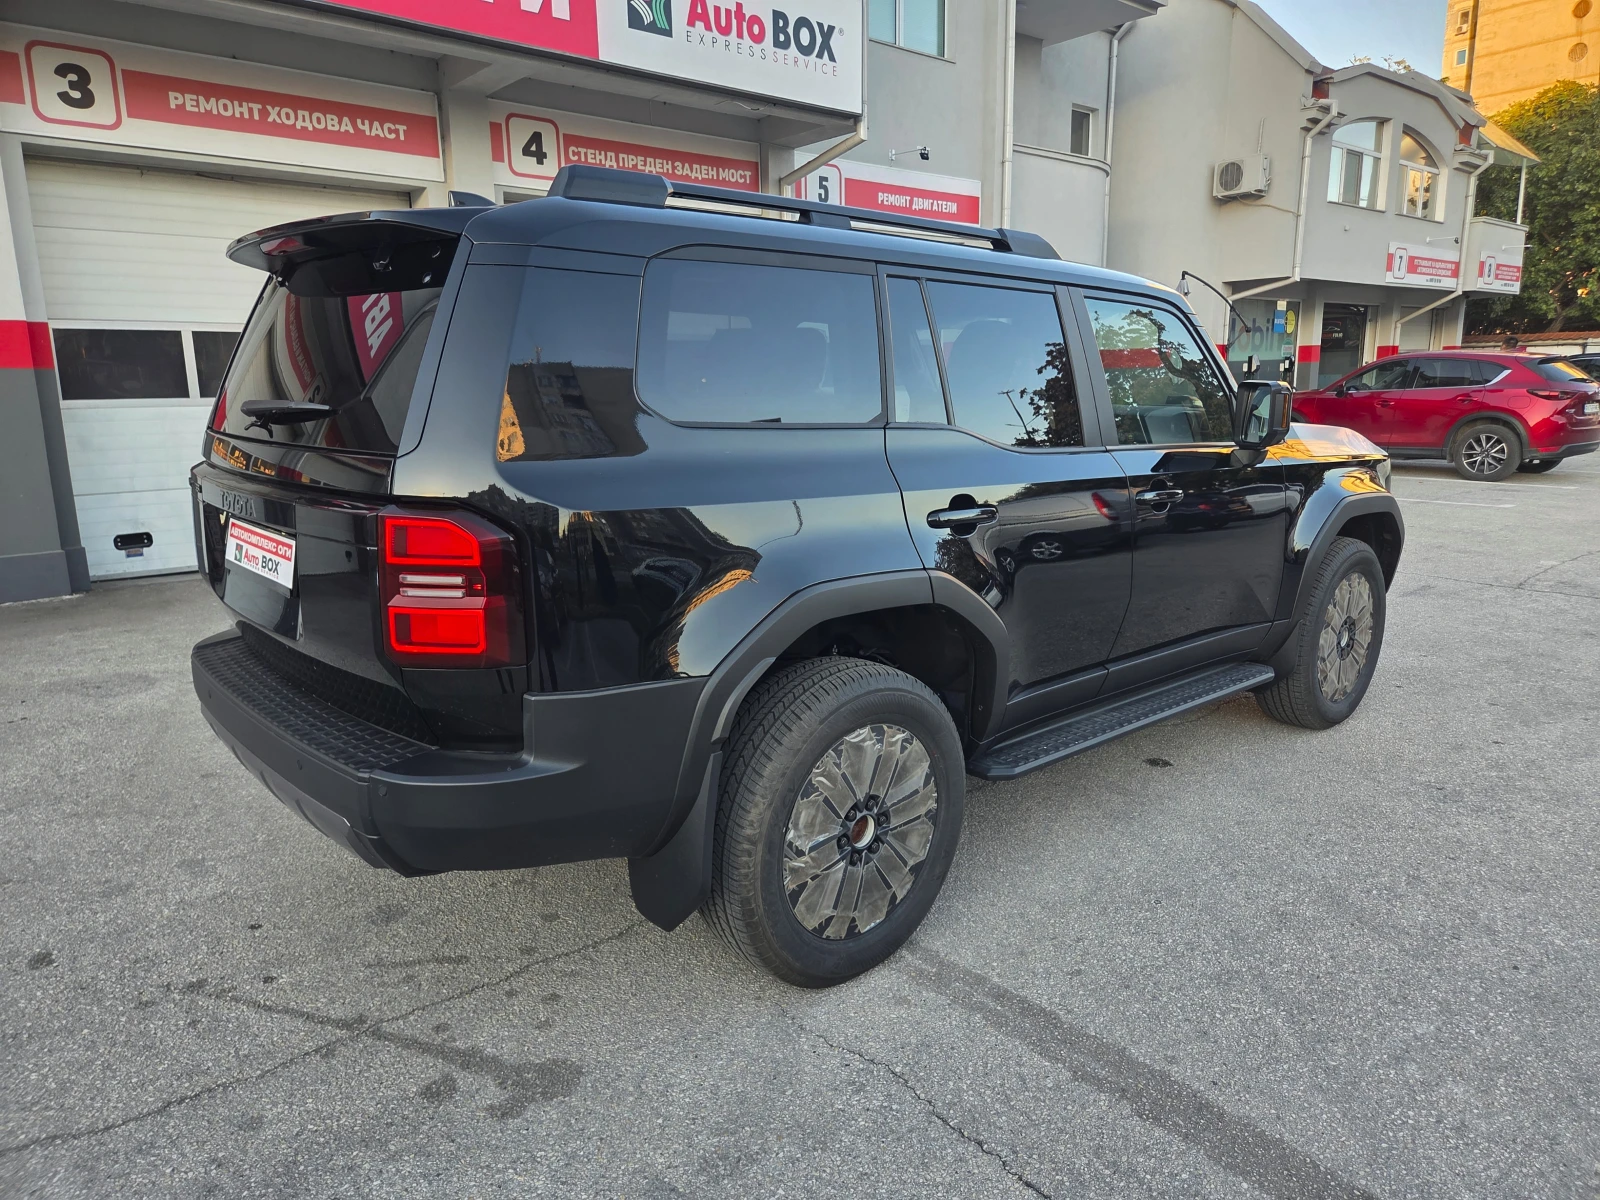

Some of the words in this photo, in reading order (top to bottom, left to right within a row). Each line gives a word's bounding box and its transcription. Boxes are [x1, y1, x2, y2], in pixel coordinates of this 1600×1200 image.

[686, 0, 766, 44] Auto
[772, 9, 837, 63] BOX
[54, 63, 95, 109] 3
[169, 91, 262, 122] РЕМОНТ
[267, 105, 354, 134] ХОДОВА
[357, 118, 407, 141] ЧАСТ
[522, 131, 547, 165] 4
[568, 146, 616, 168] СТЕНД
[618, 153, 672, 174] ПРЕДЕН
[674, 161, 717, 180] ЗАДЕН
[719, 168, 752, 184] МОСТ
[818, 175, 830, 204] 5
[878, 192, 911, 208] РЕМОНТ
[912, 197, 958, 214] ДВИГАТЕЛИ
[1398, 256, 1403, 272] 7
[221, 490, 256, 517] TOYOTA
[231, 526, 277, 552] АВТОКОМПЛЕКС
[277, 545, 292, 559] ОГИ
[261, 554, 280, 575] BOX
